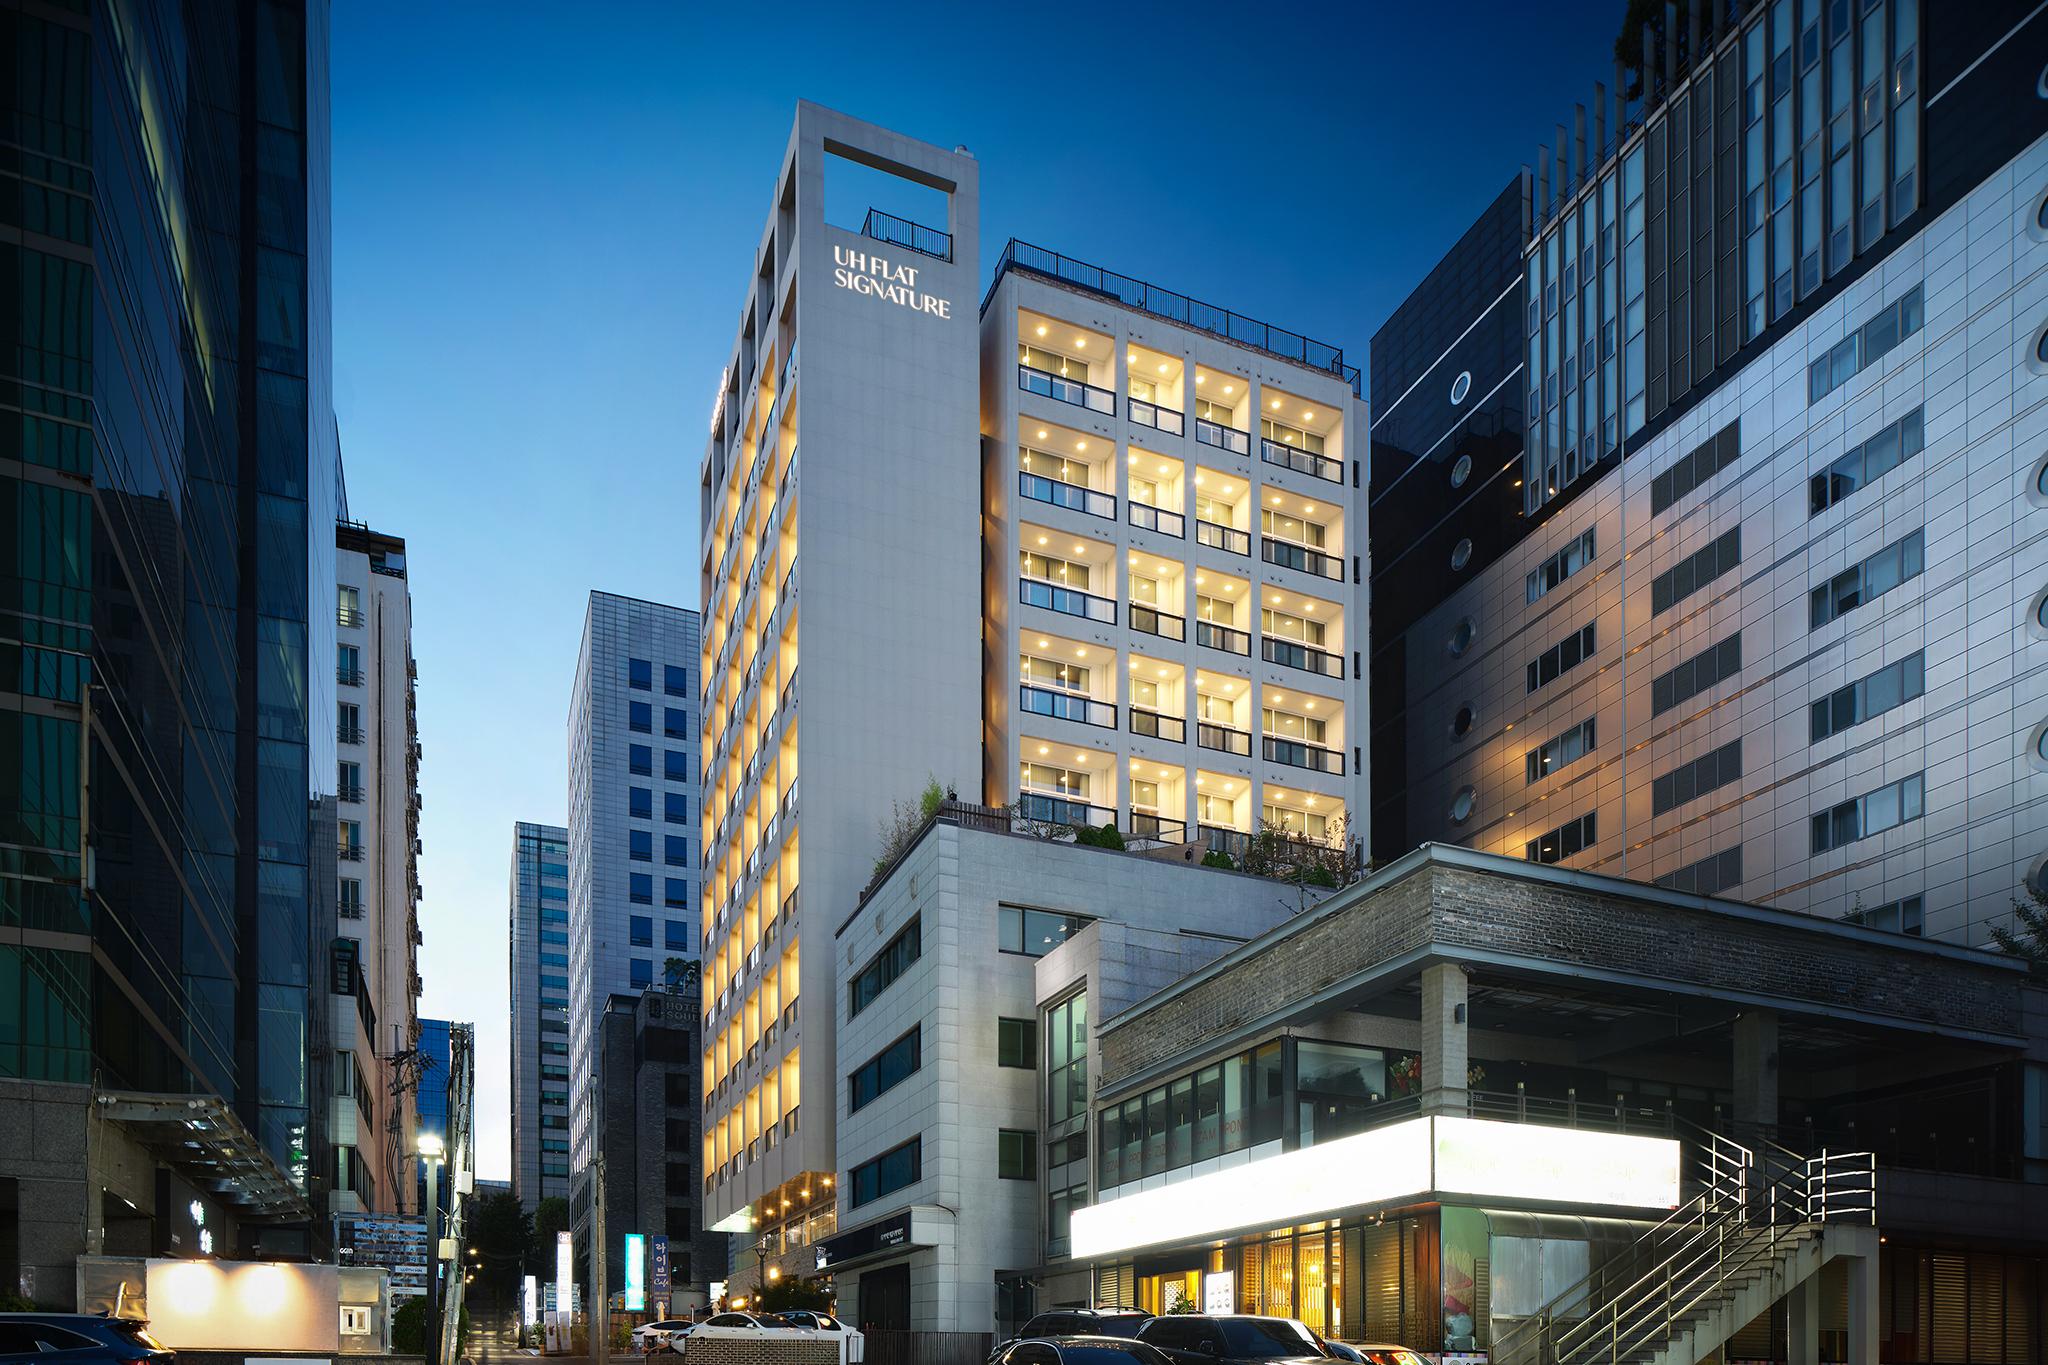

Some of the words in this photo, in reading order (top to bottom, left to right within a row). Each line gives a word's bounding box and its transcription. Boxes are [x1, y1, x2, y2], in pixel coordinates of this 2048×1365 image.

[834, 245, 866, 272] UH
[870, 255, 918, 287] FLAT
[834, 268, 951, 319] SIGNATURE
[666, 1002, 700, 1013] HOTE
[656, 1242, 667, 1277] 라이브
